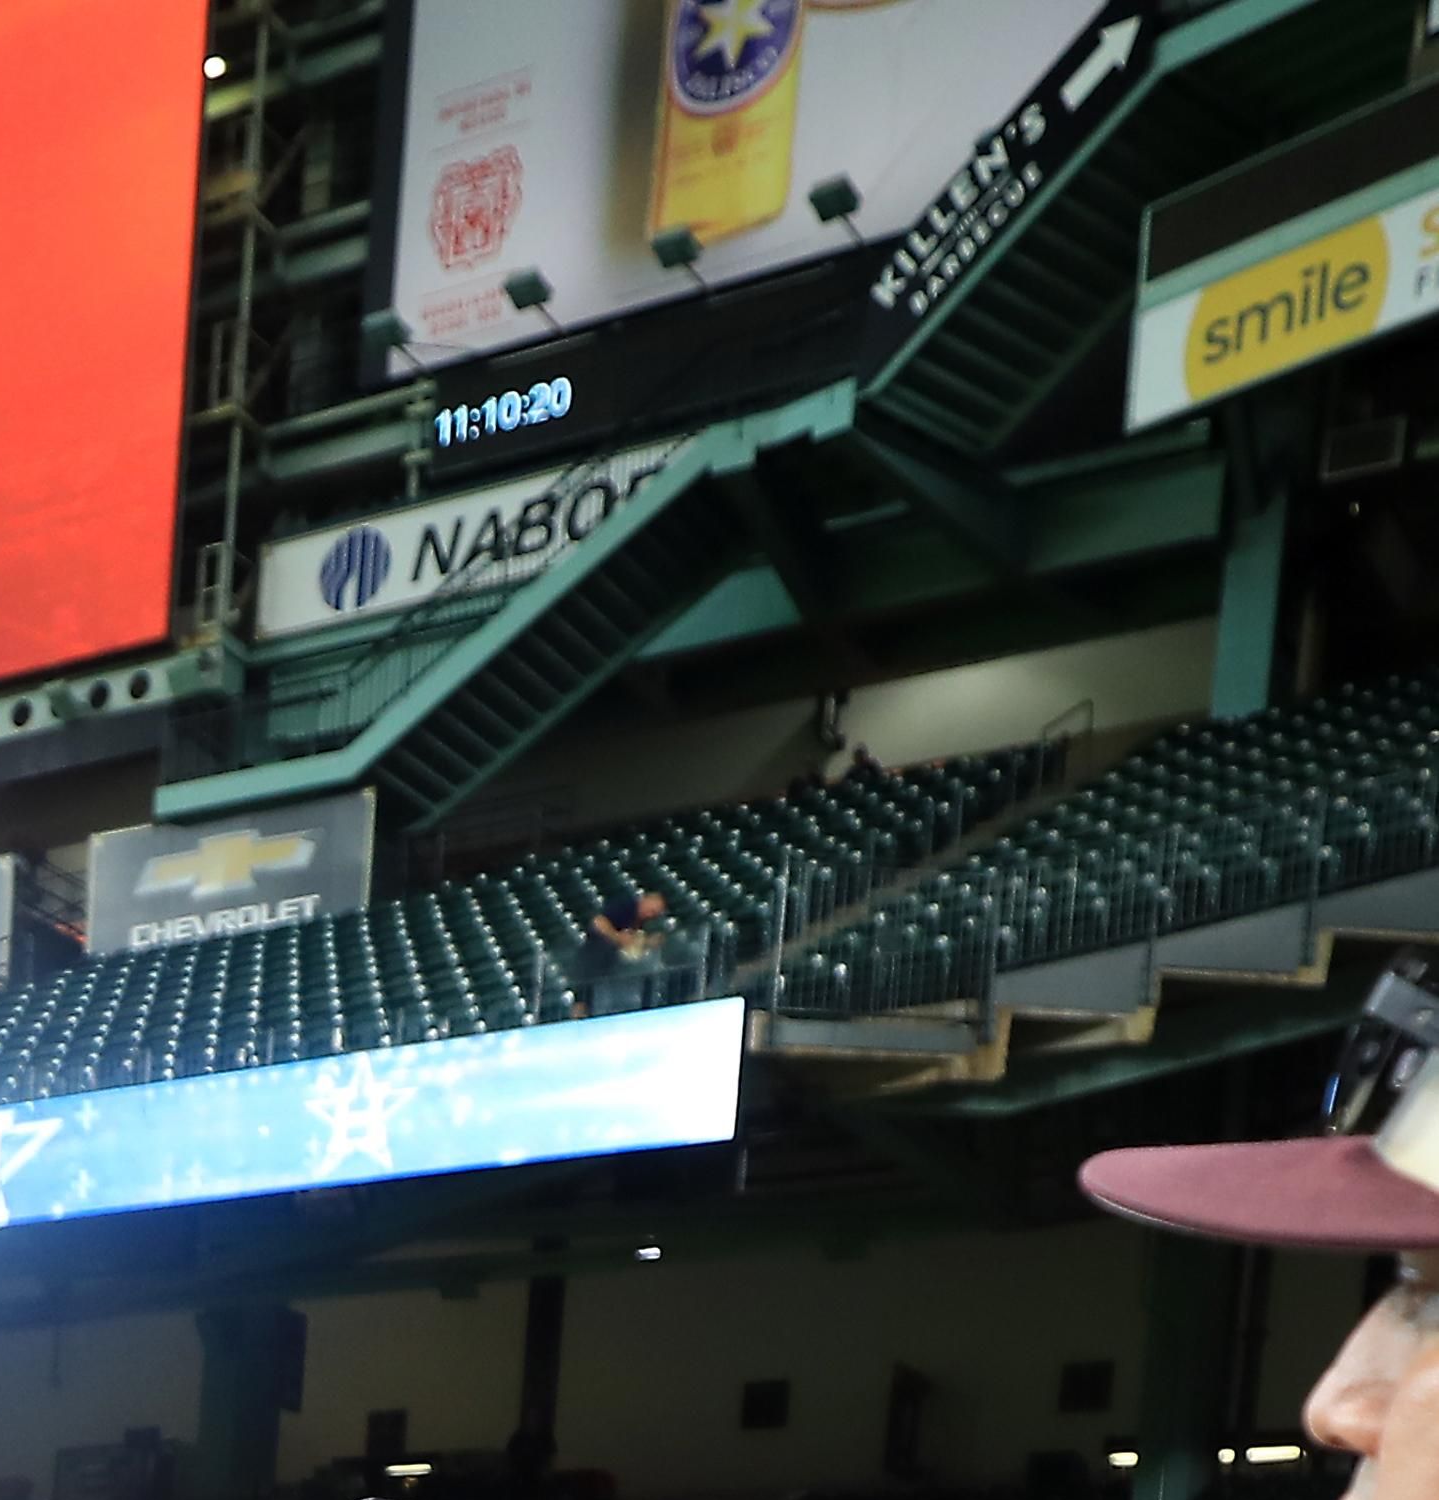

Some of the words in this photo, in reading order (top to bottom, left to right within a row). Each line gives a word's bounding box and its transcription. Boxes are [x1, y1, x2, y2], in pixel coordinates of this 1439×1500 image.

[869, 101, 1048, 309] KILLEN'S
[1202, 260, 1371, 366] smile
[434, 376, 573, 447] 11:10:20
[411, 464, 659, 582] NABO
[128, 894, 320, 948] CHEVROLET
